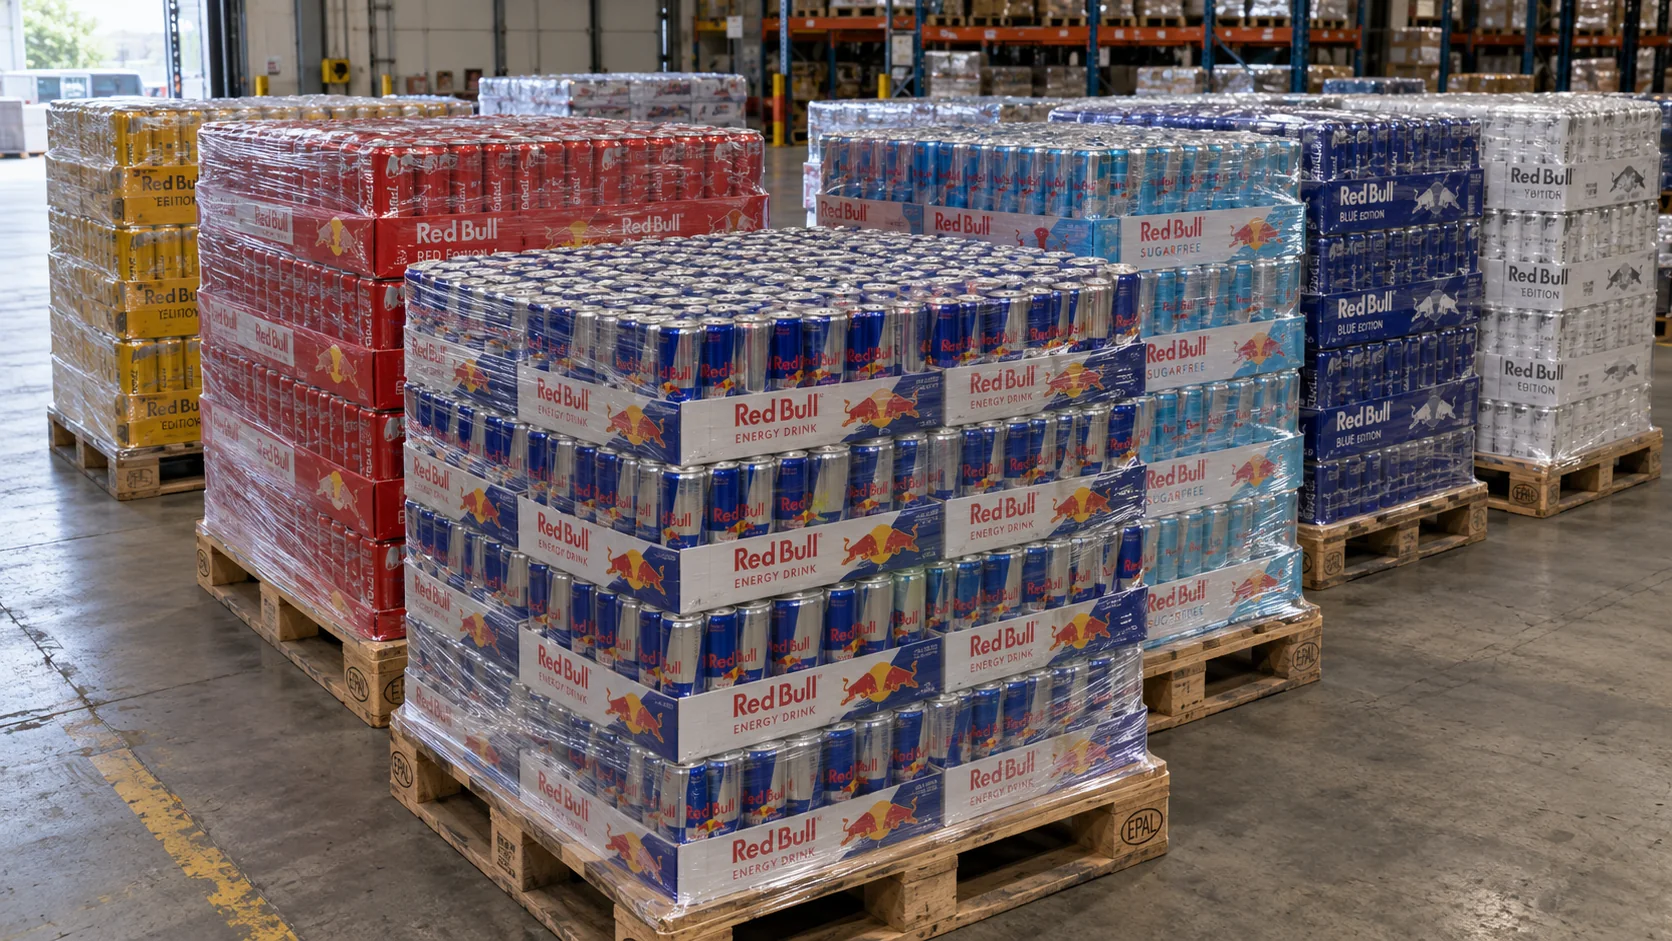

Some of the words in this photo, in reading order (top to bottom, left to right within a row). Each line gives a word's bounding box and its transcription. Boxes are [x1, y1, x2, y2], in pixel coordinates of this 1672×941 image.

[142, 175, 173, 191] Red
[176, 173, 199, 190] Bu
[1511, 168, 1540, 184] Red
[1543, 168, 1572, 186] Bull
[1340, 183, 1368, 206] Red
[1369, 181, 1394, 204] Bull
[255, 205, 270, 227] Red
[272, 210, 288, 232] Bull
[821, 201, 842, 218] Red
[845, 203, 867, 222] Bull
[1340, 210, 1358, 222] BLUE
[417, 220, 457, 244] Red
[462, 217, 497, 241] Bull
[622, 215, 651, 235] Red
[654, 214, 680, 232] Bull
[936, 212, 961, 232] Red
[964, 215, 990, 235] Bull
[1141, 219, 1170, 242] Red
[1174, 216, 1202, 239] Bull
[418, 250, 441, 262] RED
[1508, 266, 1537, 284] Red
[1540, 268, 1568, 286] Bull
[145, 288, 175, 304] Red
[179, 287, 198, 302] Bu
[1338, 294, 1366, 319] Red
[1368, 291, 1392, 314] Bull
[255, 323, 271, 347] Red
[272, 329, 288, 353] Bull
[1338, 322, 1356, 336] BLUE
[412, 336, 428, 360] Red
[429, 343, 446, 365] Bull
[847, 348, 871, 362] Red
[1147, 340, 1176, 364] Red
[1179, 336, 1206, 359] Bull
[670, 366, 690, 380] Bull
[702, 362, 728, 378] Red
[774, 355, 798, 370] Red
[1505, 360, 1533, 378] Red
[1536, 364, 1564, 380] Bull
[970, 369, 1002, 394] Red
[1006, 365, 1035, 390] Bull
[537, 377, 562, 404] Red
[564, 383, 588, 412] Bull
[970, 397, 1004, 410] ENERGY
[1008, 393, 1032, 404] DRINK
[148, 400, 177, 417] Red
[181, 399, 200, 413] Bu
[735, 398, 776, 427] Red
[780, 393, 818, 422] Bull
[1336, 406, 1364, 432] Red
[1366, 400, 1390, 426] Bull
[736, 428, 780, 444] ENERGY
[784, 424, 817, 440] DRINK
[1336, 434, 1354, 448] BLUE
[257, 438, 273, 462] Red
[274, 447, 289, 472] Bull
[414, 456, 431, 482] Red
[432, 466, 450, 491] Bull
[964, 464, 985, 478] Red
[1146, 464, 1175, 490] Red
[1178, 459, 1205, 484] Bull
[870, 482, 888, 496] Bull
[714, 504, 739, 522] Red
[781, 496, 806, 512] Red
[970, 498, 1002, 524] Red
[1006, 492, 1035, 518] Bull
[538, 511, 562, 541] Red
[564, 523, 588, 552] Bull
[670, 512, 692, 528] Bull
[970, 526, 1004, 540] ENERGY
[1008, 520, 1034, 532] DRINK
[566, 548, 588, 567] DRINK
[734, 539, 776, 572] Red
[780, 532, 818, 564] Bull
[735, 571, 780, 588] ENERGY
[784, 564, 817, 582] DRINK
[414, 574, 432, 602] Red
[433, 585, 450, 612] Bull
[1148, 587, 1176, 614] Red
[1178, 580, 1206, 605] Bull
[790, 636, 810, 652] Bull
[830, 626, 855, 642] Red
[970, 628, 1002, 658] Red
[1006, 620, 1034, 649] Bull
[538, 644, 562, 676] Red
[564, 657, 588, 690] Bull
[709, 652, 734, 668] Red
[970, 656, 1004, 673] ENERGY
[1008, 648, 1034, 662] DRINK
[416, 686, 433, 715] Red
[733, 684, 776, 718] Red
[779, 675, 817, 708] Bull
[734, 717, 778, 735] ENERGY
[782, 706, 816, 725] DRINK
[828, 766, 853, 783] Red
[970, 760, 1002, 791] Red
[1005, 750, 1035, 780] Bull
[538, 770, 562, 804] Red
[564, 786, 589, 822] Bull
[766, 784, 785, 802] Bull
[970, 788, 1004, 806] ENERGY
[686, 802, 710, 820] Red
[713, 798, 734, 816] Bull
[1128, 814, 1156, 840] EPAL
[732, 829, 774, 864] Red
[778, 817, 816, 850] Bull
[732, 862, 777, 881] ENERGY
[781, 847, 816, 868] DRINK
